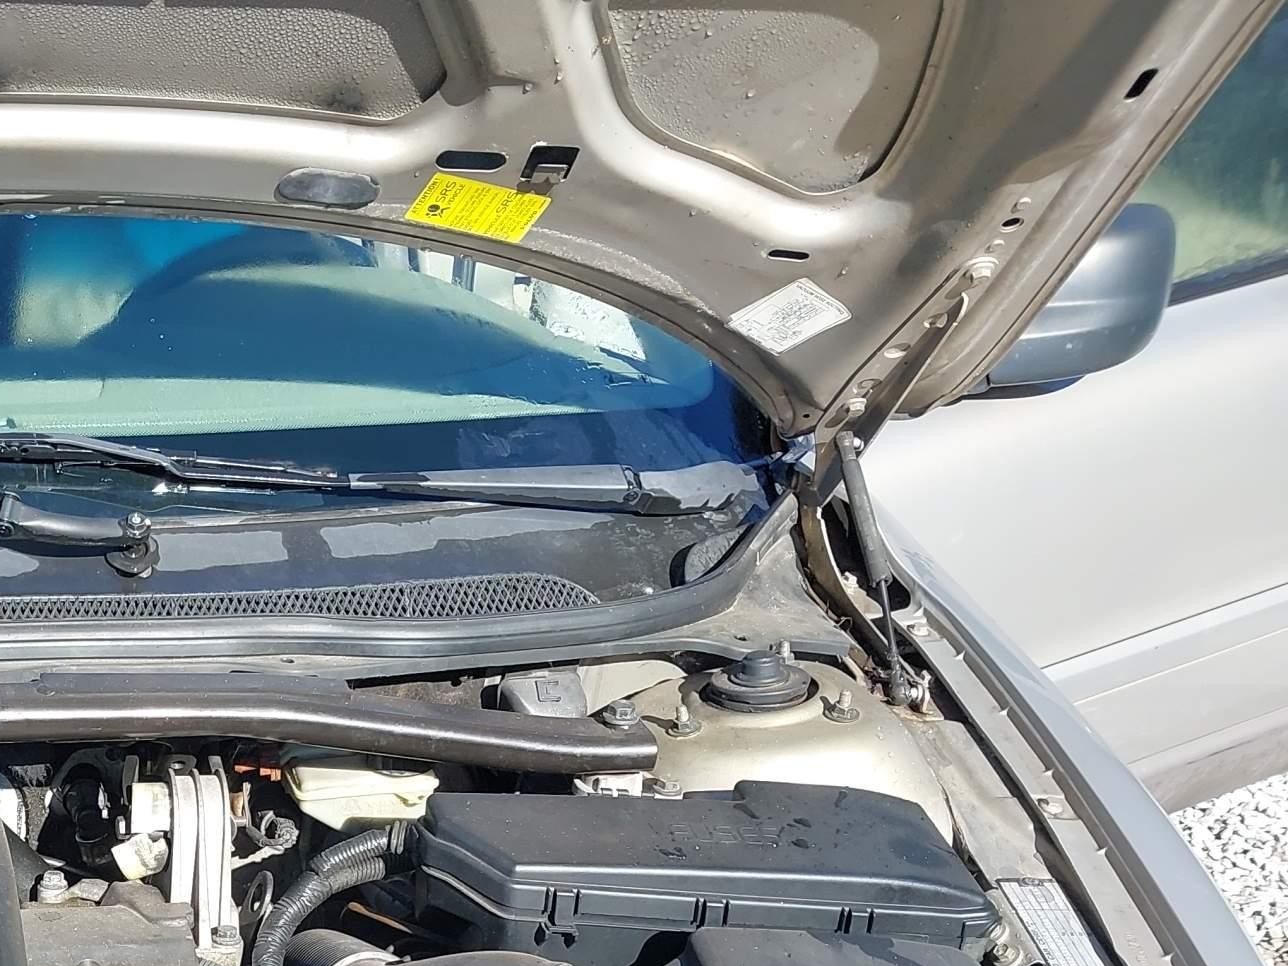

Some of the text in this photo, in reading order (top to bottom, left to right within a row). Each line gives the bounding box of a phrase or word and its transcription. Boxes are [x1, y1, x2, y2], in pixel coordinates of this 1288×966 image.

[435, 181, 457, 202] SRS
[496, 191, 518, 213] SRS
[668, 822, 778, 845] FUSES
